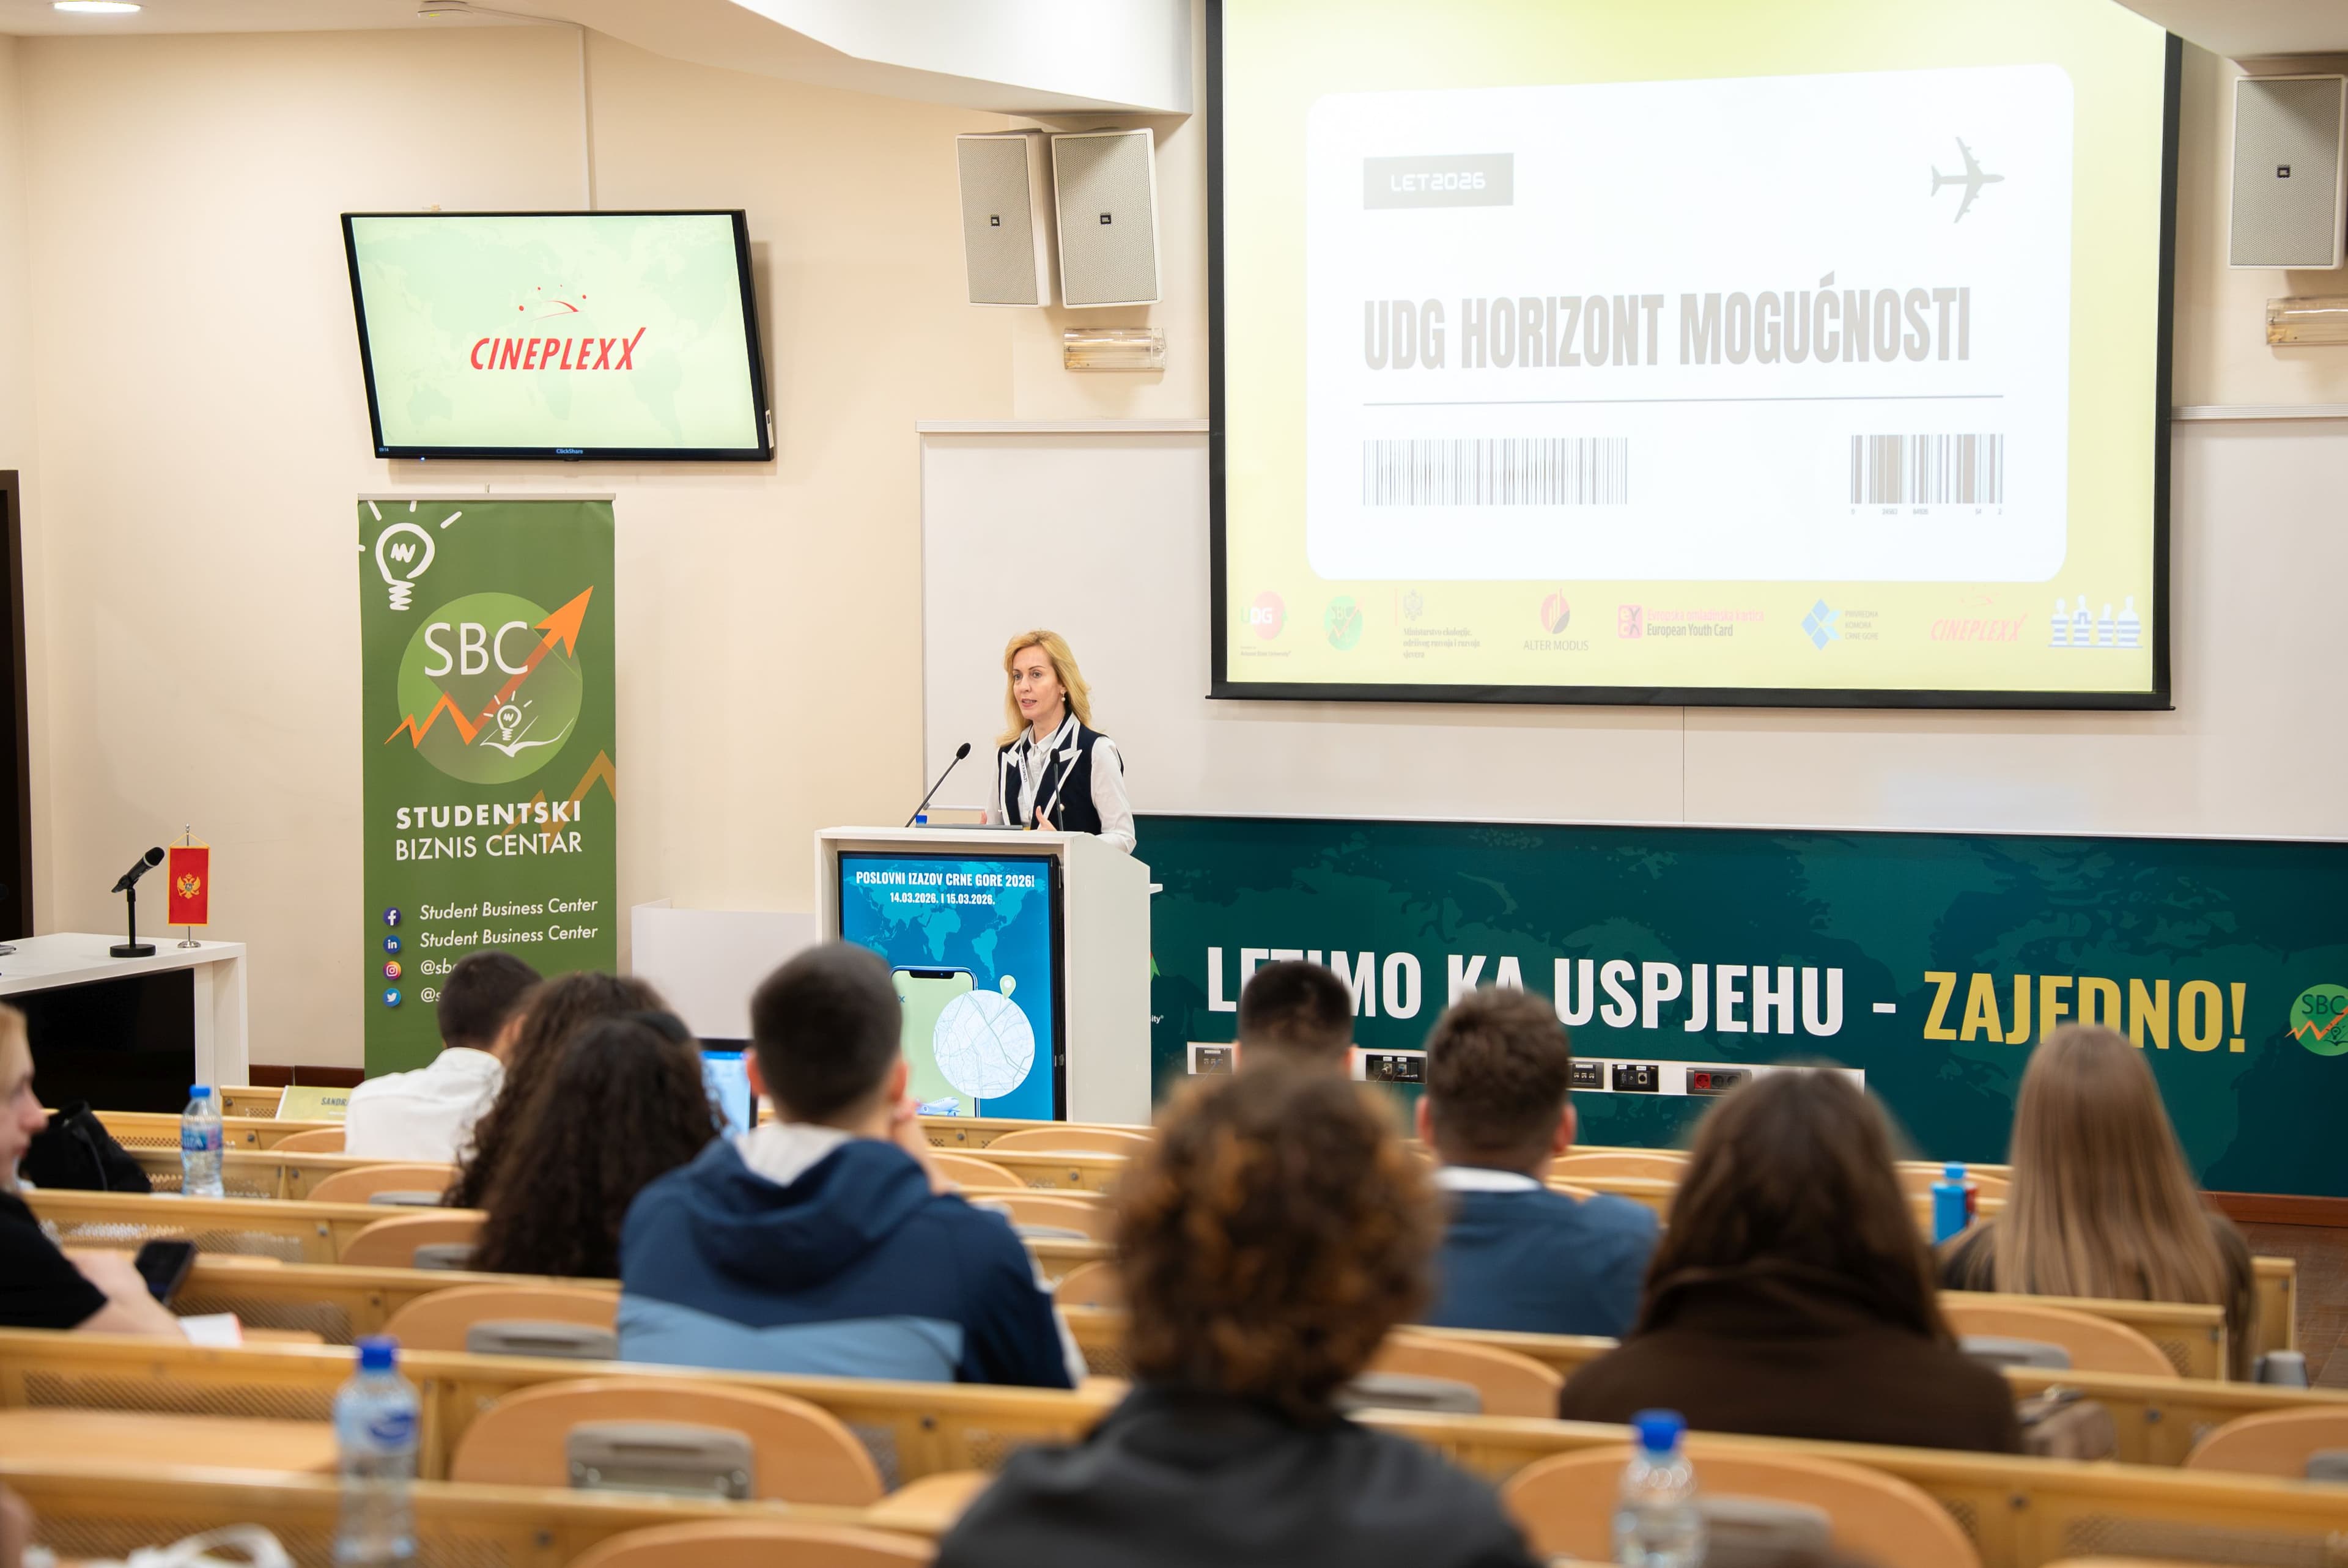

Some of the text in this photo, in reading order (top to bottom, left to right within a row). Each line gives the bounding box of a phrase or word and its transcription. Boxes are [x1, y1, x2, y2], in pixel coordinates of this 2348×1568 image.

[1390, 172, 1486, 191] LET2026
[1364, 271, 1971, 370] UDG HORIZONT MOGUĆNOSTI
[471, 327, 646, 370] CINEPLEXX
[1647, 623, 1733, 638] European Youth Card
[1930, 611, 2030, 641] CINEPLEXX
[424, 621, 528, 676] SBC
[1523, 640, 1589, 651] ALTER MODUS
[396, 801, 580, 829] STUDENTSKI
[396, 832, 583, 861] BIZNIS CENTAR
[856, 872, 1035, 887] POSLOVNI IZAZOV CRNE GORE 2026!
[419, 898, 598, 921] Student Business Center
[890, 893, 939, 904] 14.03.2026.
[947, 894, 995, 905] 15.03.2026.
[420, 925, 598, 948] Student Business Center
[421, 957, 457, 975] @sb
[1554, 959, 1843, 1036] USPJEHU
[1924, 971, 2246, 1053] ZAJEDNO!
[2302, 993, 2346, 1016] SBC
[320, 1097, 349, 1106] SANDR
